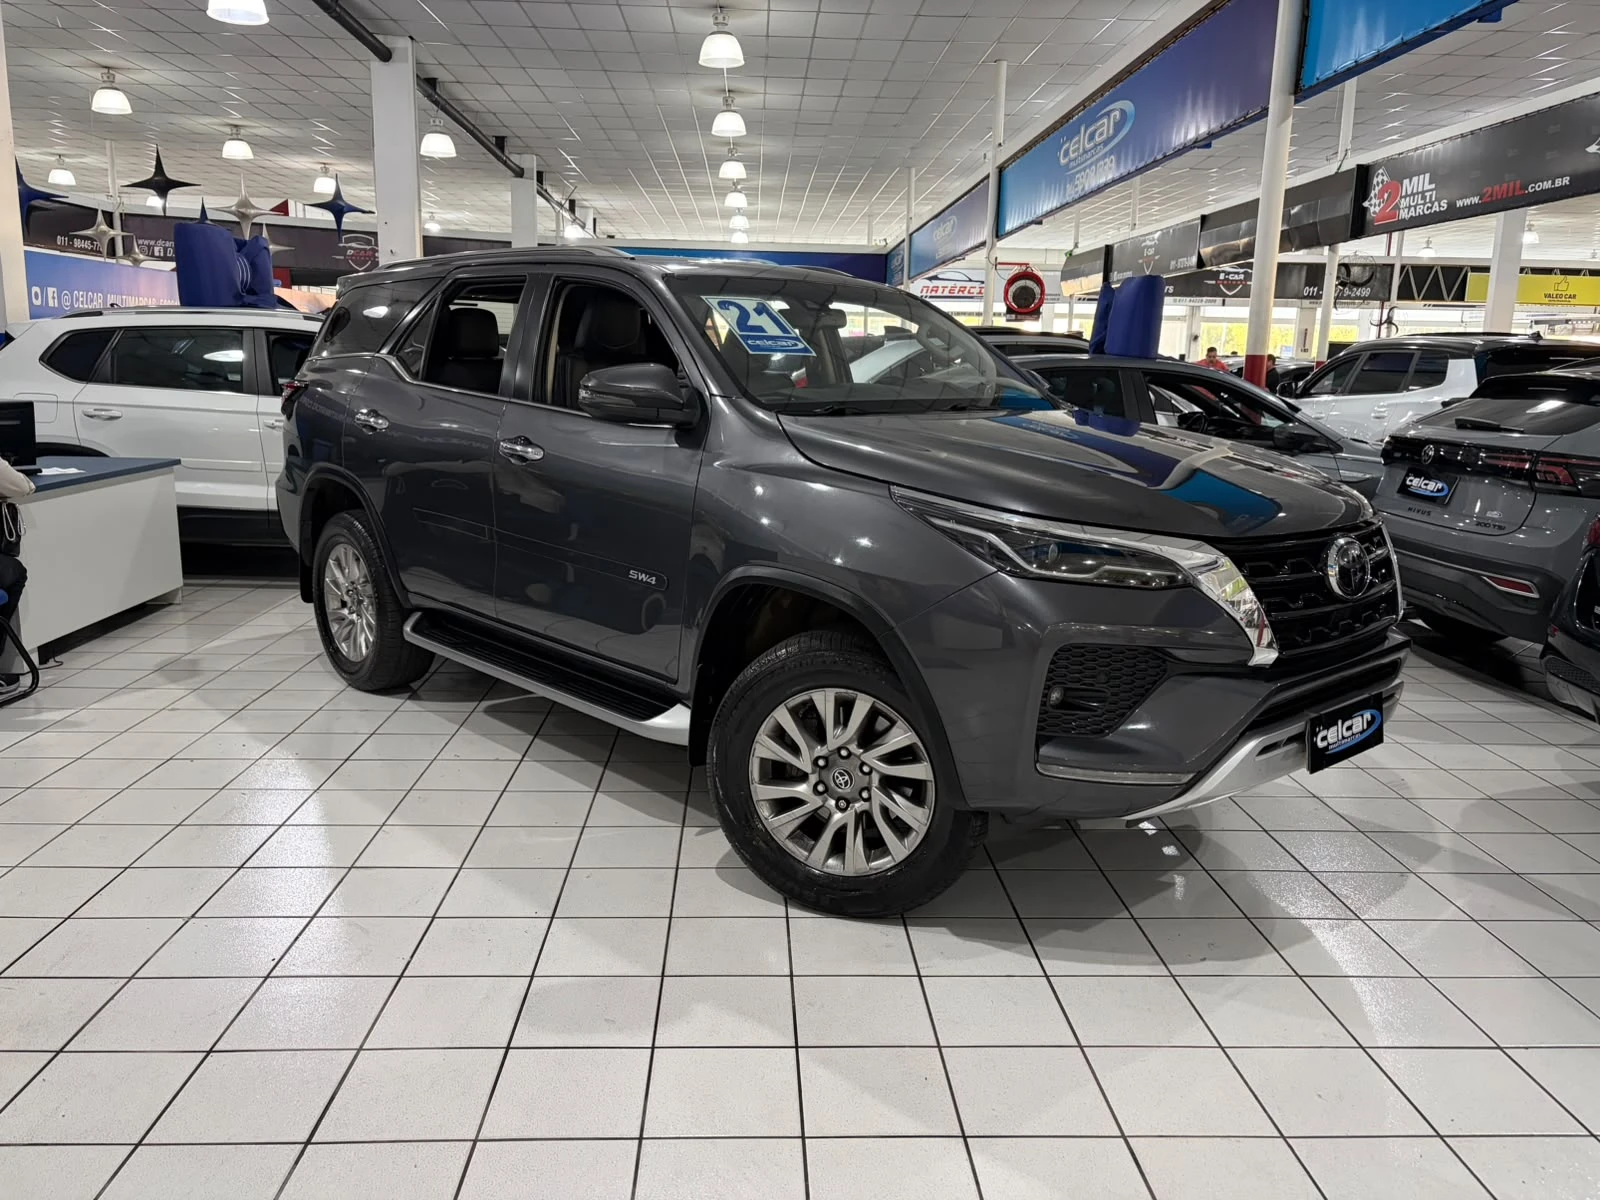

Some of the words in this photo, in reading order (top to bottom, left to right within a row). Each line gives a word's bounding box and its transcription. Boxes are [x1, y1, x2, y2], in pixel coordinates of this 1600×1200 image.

[1060, 110, 1120, 166] celcar
[1402, 172, 1435, 196] MIL
[1374, 180, 1401, 225] 2
[1401, 190, 1436, 208] MULTI
[1399, 199, 1448, 221] MARCAS
[57, 235, 68, 246] 011
[920, 283, 985, 295] NATÉRCI
[1303, 286, 1318, 296] 011
[717, 300, 793, 335] 21
[747, 339, 794, 347] celcar
[1405, 476, 1442, 492] celcar
[628, 569, 657, 585] SW4
[1316, 711, 1372, 749] celcar
